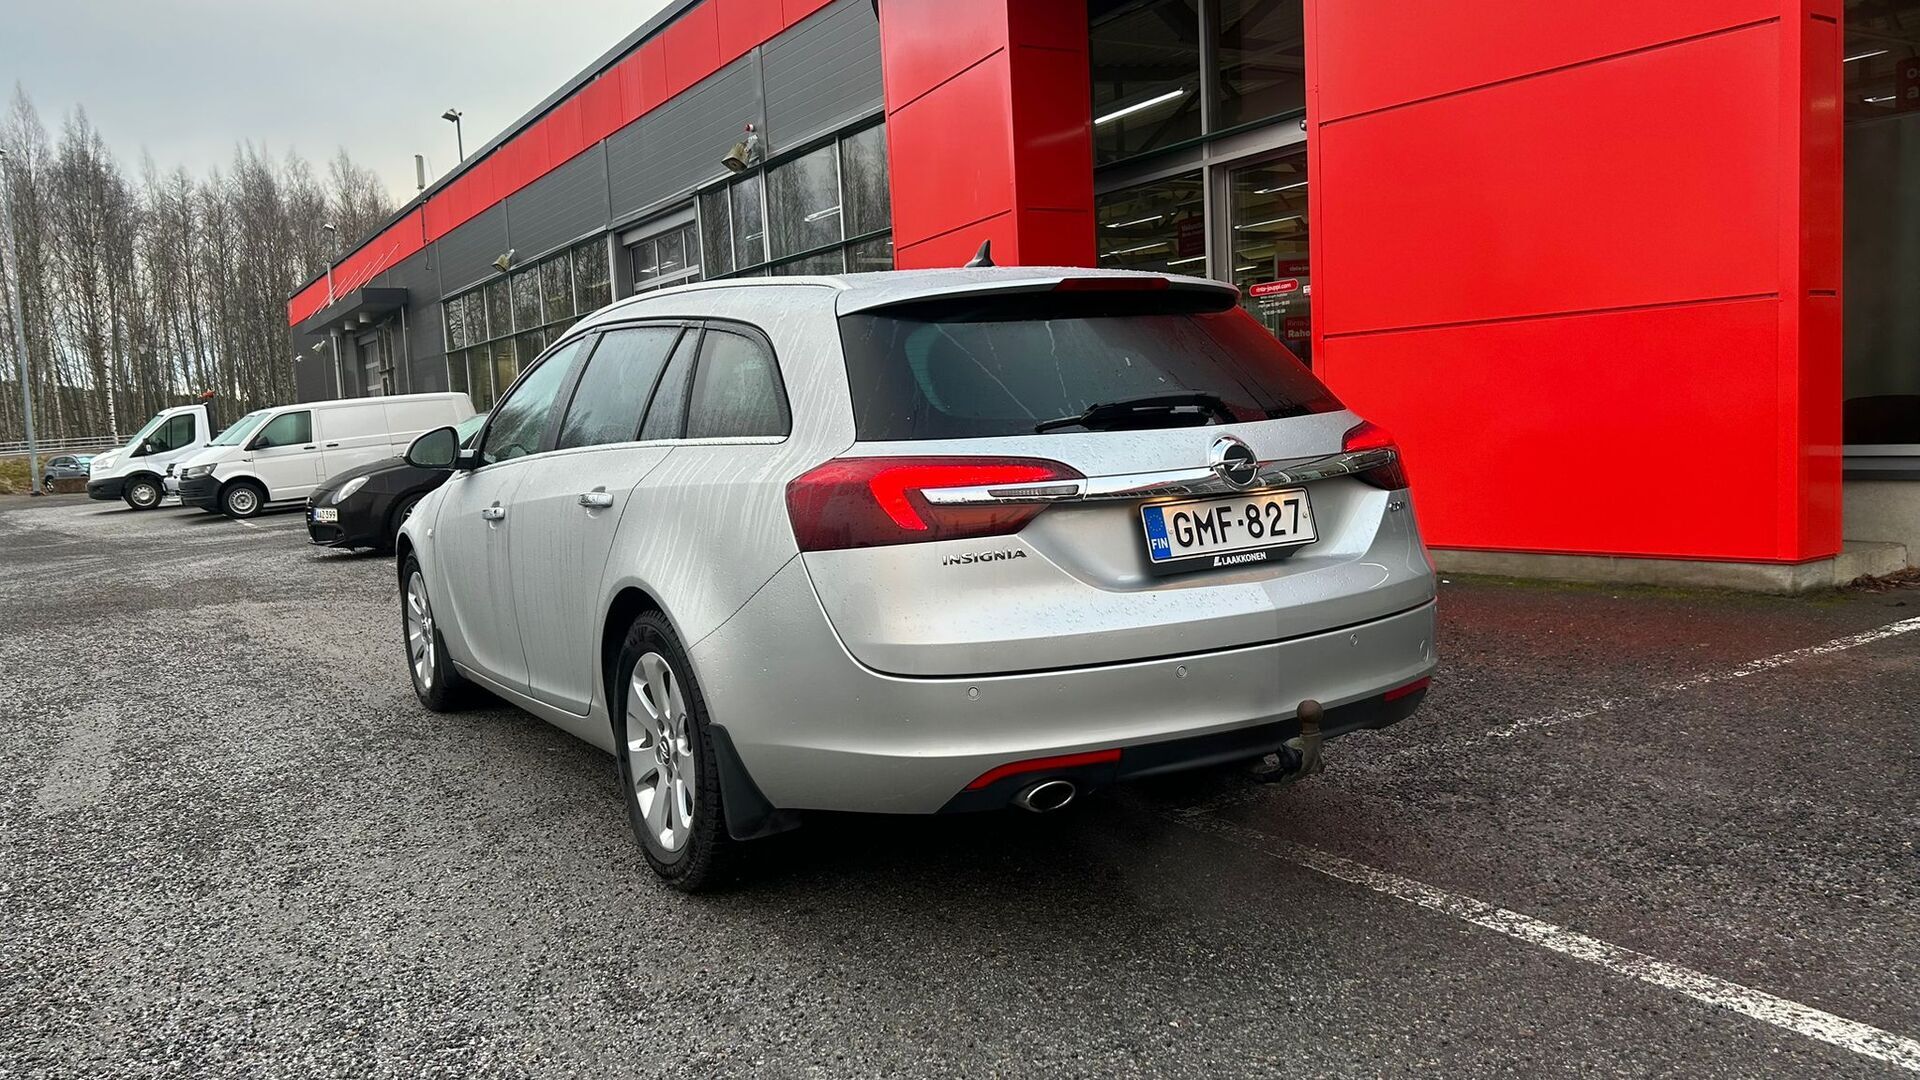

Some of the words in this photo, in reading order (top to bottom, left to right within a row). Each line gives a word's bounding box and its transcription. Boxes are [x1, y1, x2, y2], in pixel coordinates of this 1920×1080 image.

[1151, 538, 1168, 550] FIN
[1173, 500, 1300, 548] GMF-827
[942, 548, 1027, 566] INSIGNIA
[1222, 551, 1267, 566] LAAKKONEN
